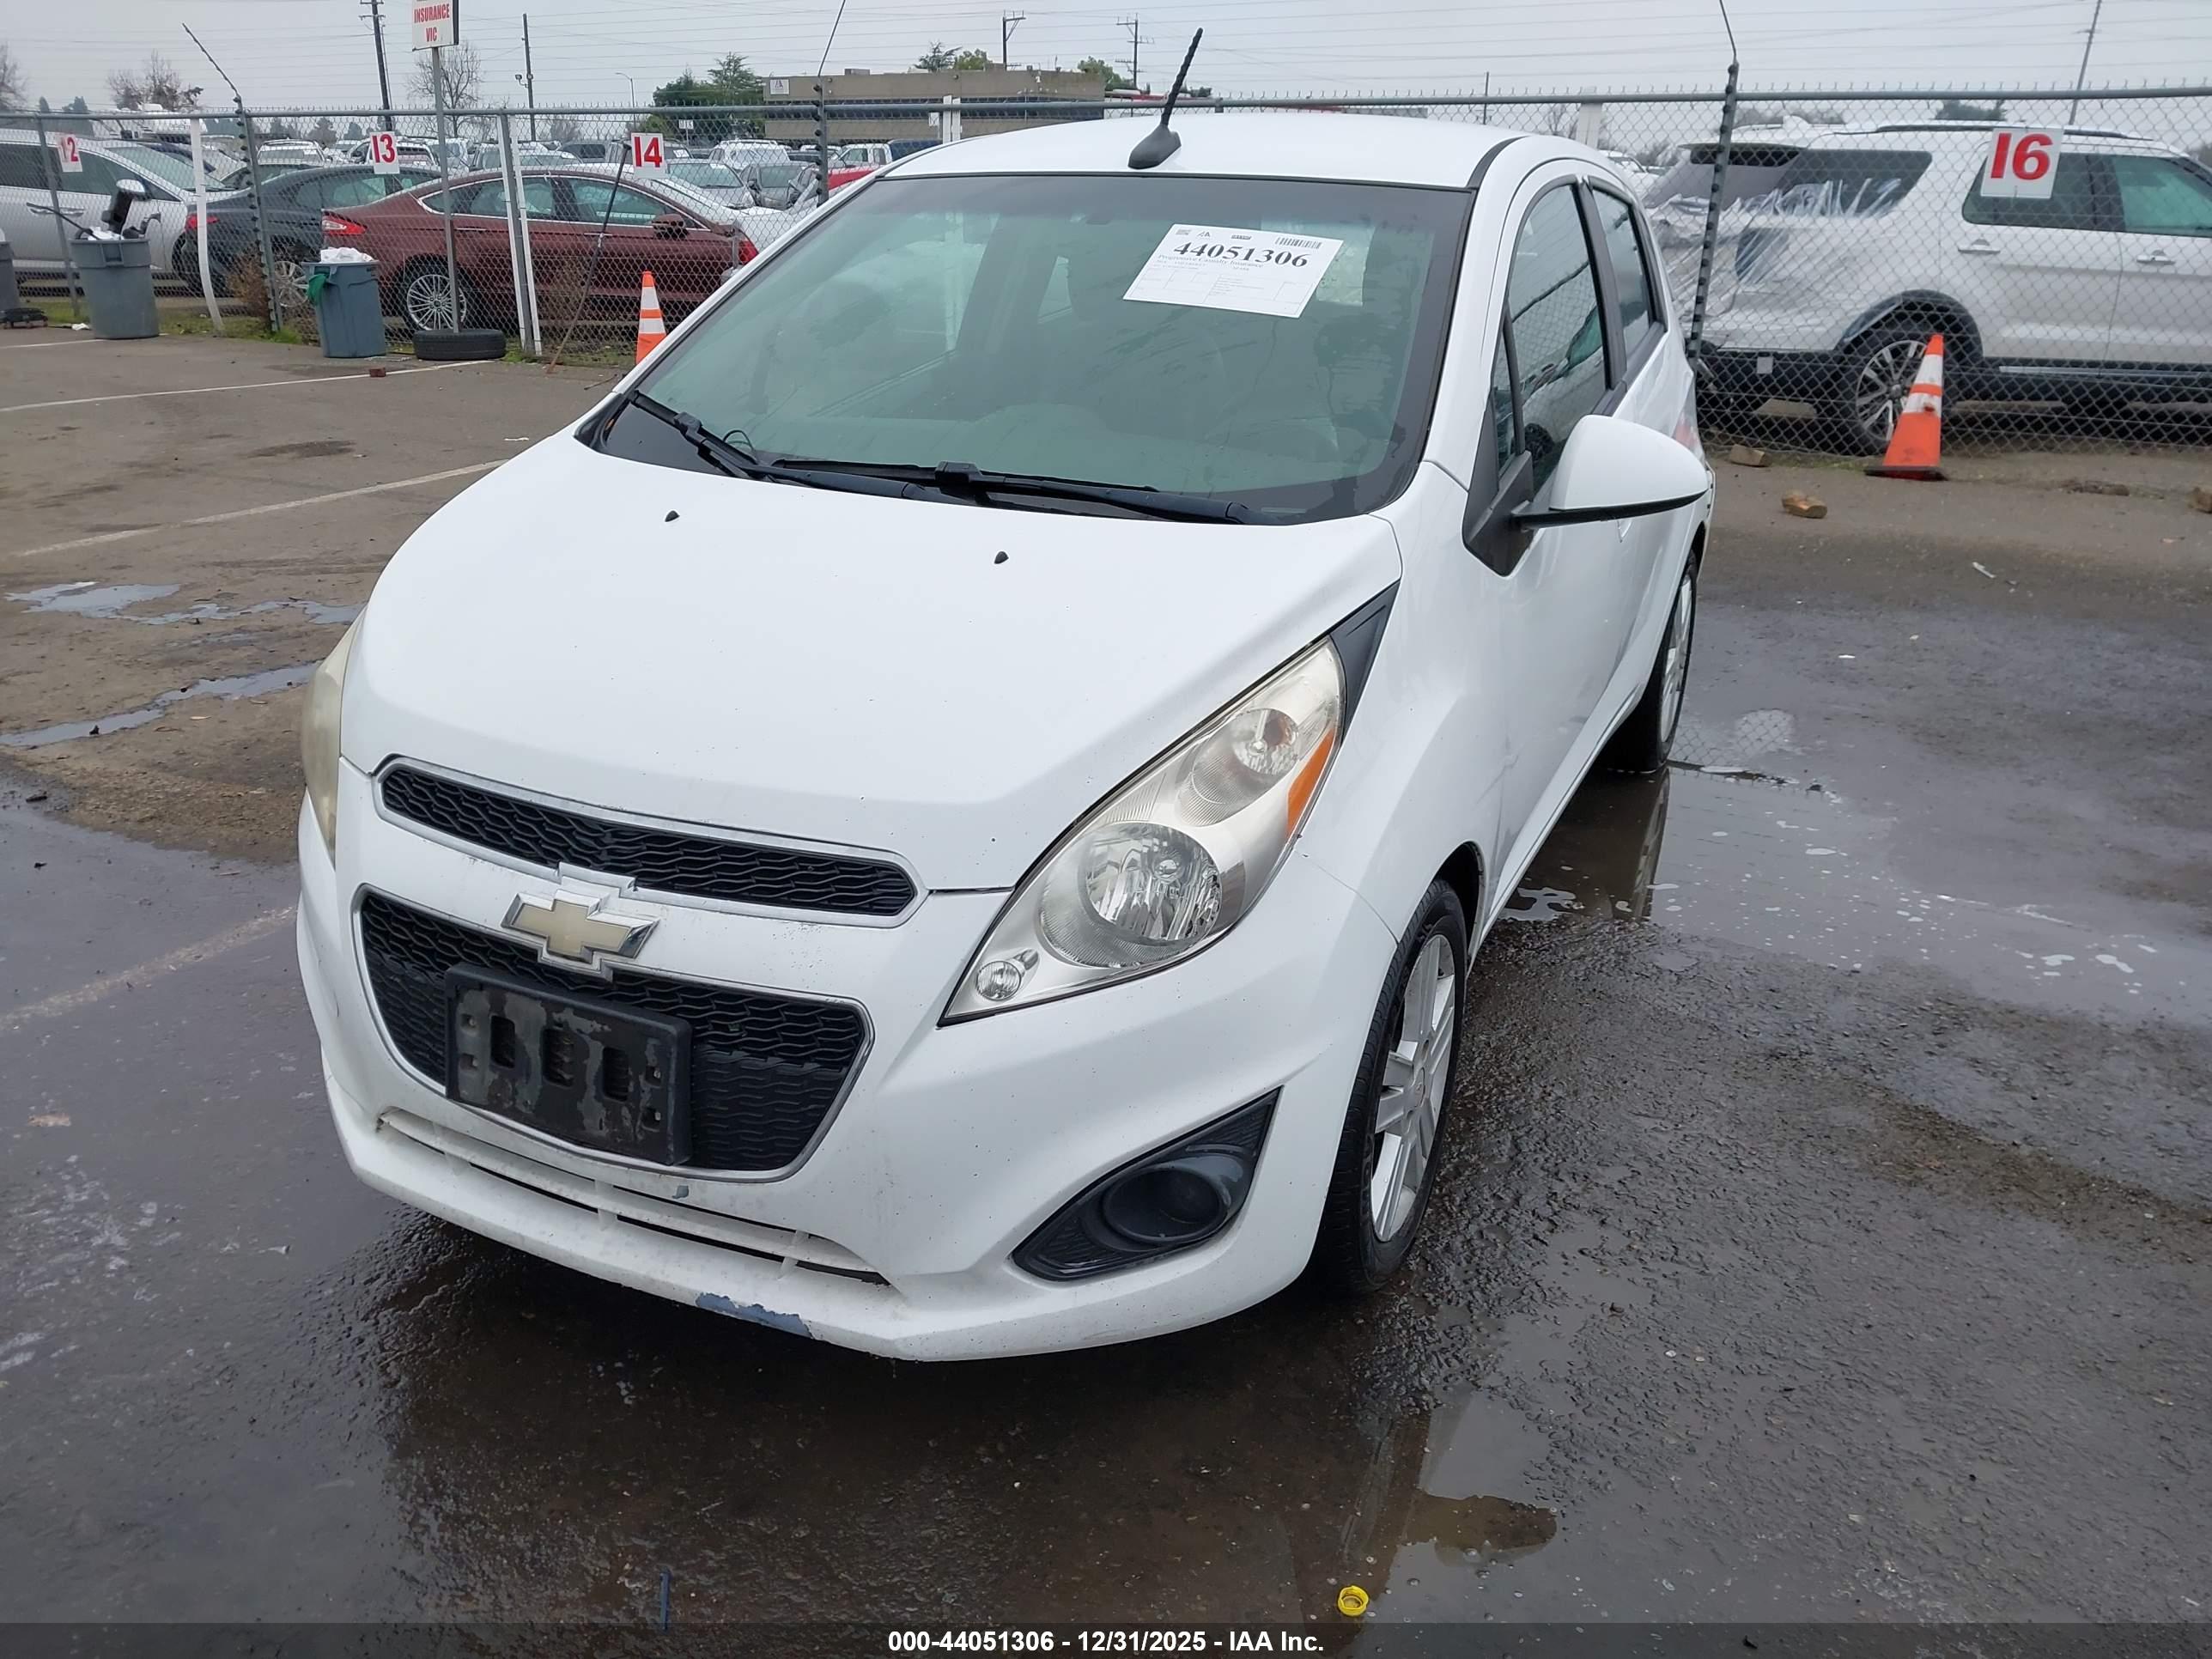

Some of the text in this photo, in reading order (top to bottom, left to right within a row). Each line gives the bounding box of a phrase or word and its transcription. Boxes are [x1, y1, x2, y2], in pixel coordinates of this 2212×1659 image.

[413, 3, 450, 23] INSURANCE
[426, 27, 437, 42] VIC
[372, 133, 395, 163] 13
[634, 136, 662, 167] 14
[1990, 132, 2053, 180] 16
[1173, 241, 1311, 268] 44051306
